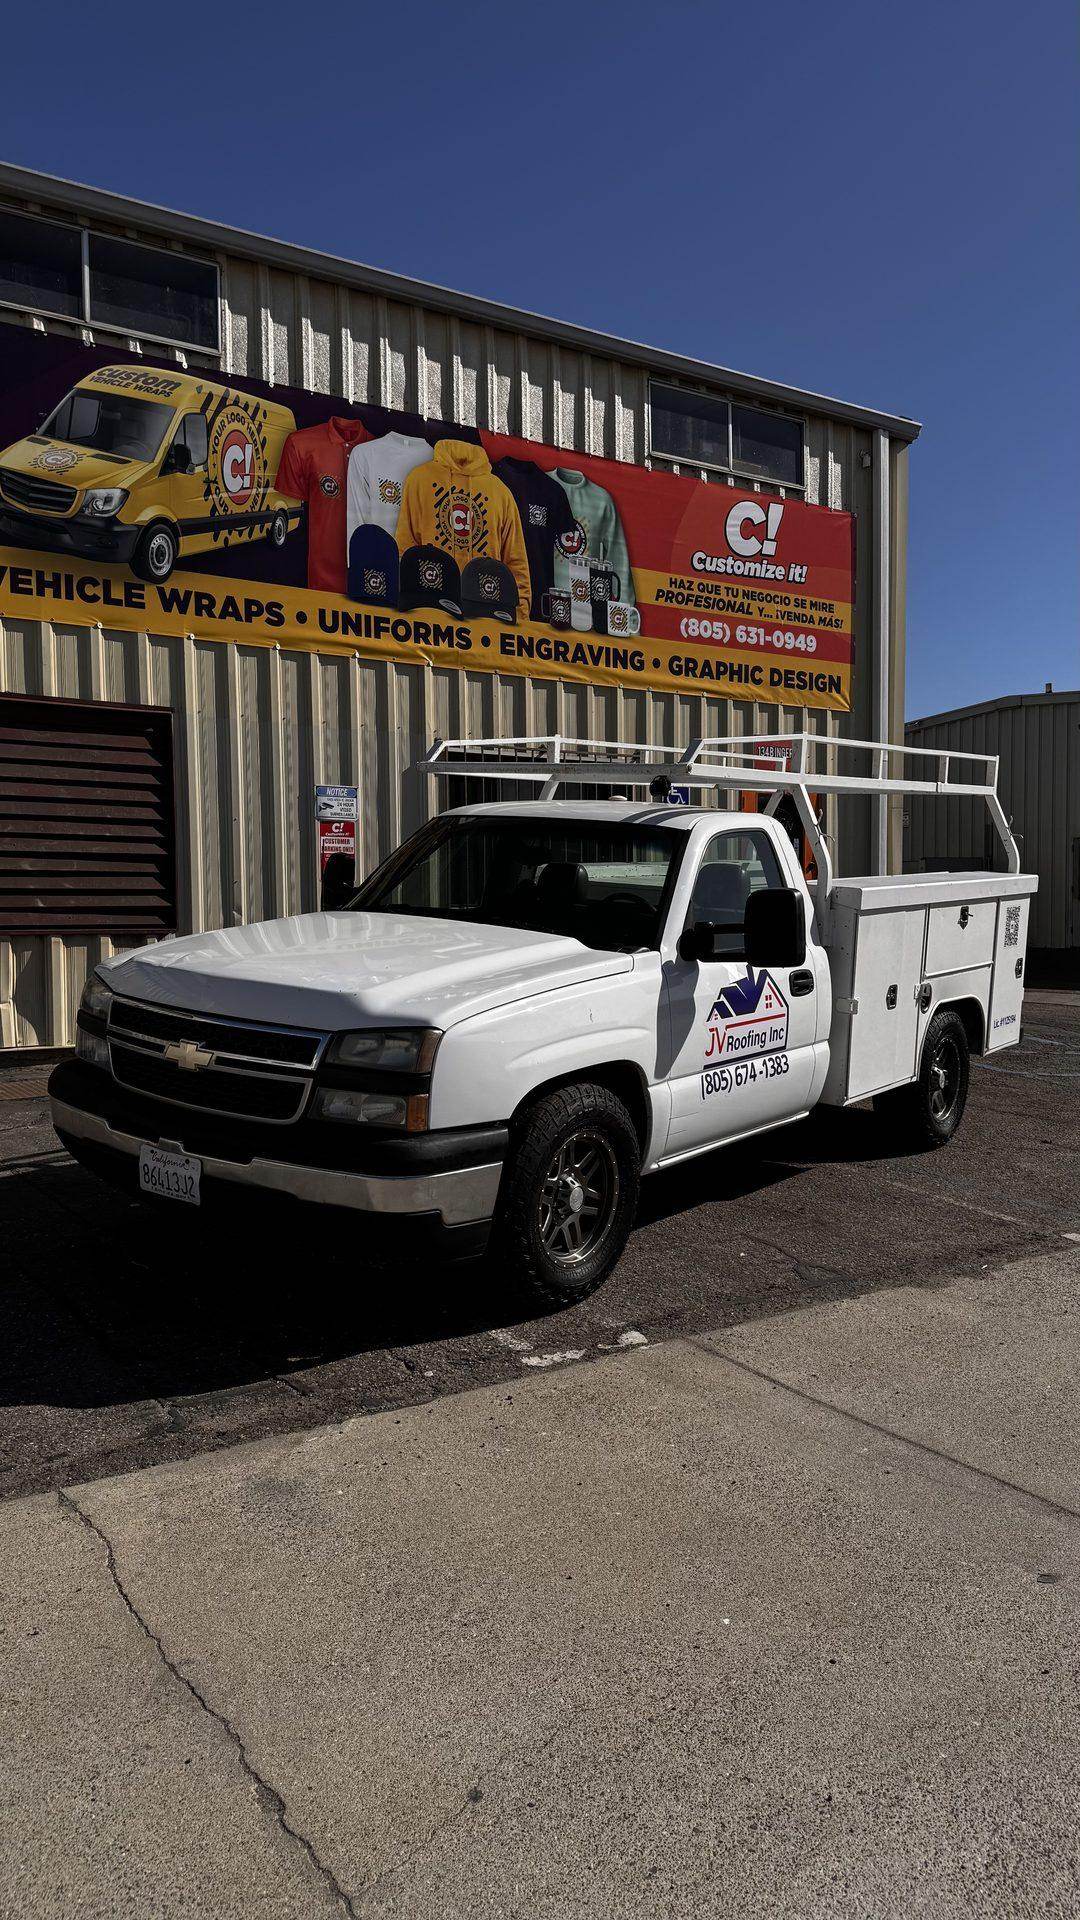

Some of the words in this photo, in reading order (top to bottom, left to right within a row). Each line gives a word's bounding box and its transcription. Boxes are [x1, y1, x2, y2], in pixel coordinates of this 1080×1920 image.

[90, 375, 133, 389] VEHICLE
[134, 384, 174, 398] WRAPS
[97, 368, 182, 391] custom
[212, 419, 227, 455] YOUR
[226, 412, 246, 426] LOGO
[223, 443, 253, 493] C!
[450, 510, 474, 531] C!
[725, 500, 784, 557] C!
[691, 551, 785, 582] Customize
[787, 563, 808, 585] it!
[655, 588, 753, 616] PROFESIONAL
[757, 606, 773, 619] Y...
[818, 614, 844, 629] MÁS!
[669, 577, 694, 592] HAZ
[698, 581, 721, 597] QUE
[724, 586, 739, 599] TU
[742, 589, 791, 607] NEGOCIO
[794, 597, 807, 609] SE
[810, 600, 835, 614] MIRE
[156, 586, 285, 627] WRAPS
[318, 609, 472, 651] UNIFORMS
[500, 633, 645, 672] ENGRAVING
[668, 655, 763, 686] GRAPHIC
[769, 667, 842, 694] DESIGN
[680, 617, 731, 644] (805)
[735, 624, 817, 653] 631-0949
[326, 788, 348, 796] NOTICE
[705, 1027, 726, 1057] JV
[727, 1030, 767, 1052] Roofing
[769, 1026, 784, 1042] Inc
[701, 1068, 732, 1100] (805)
[143, 1163, 196, 1198] 86413J2
